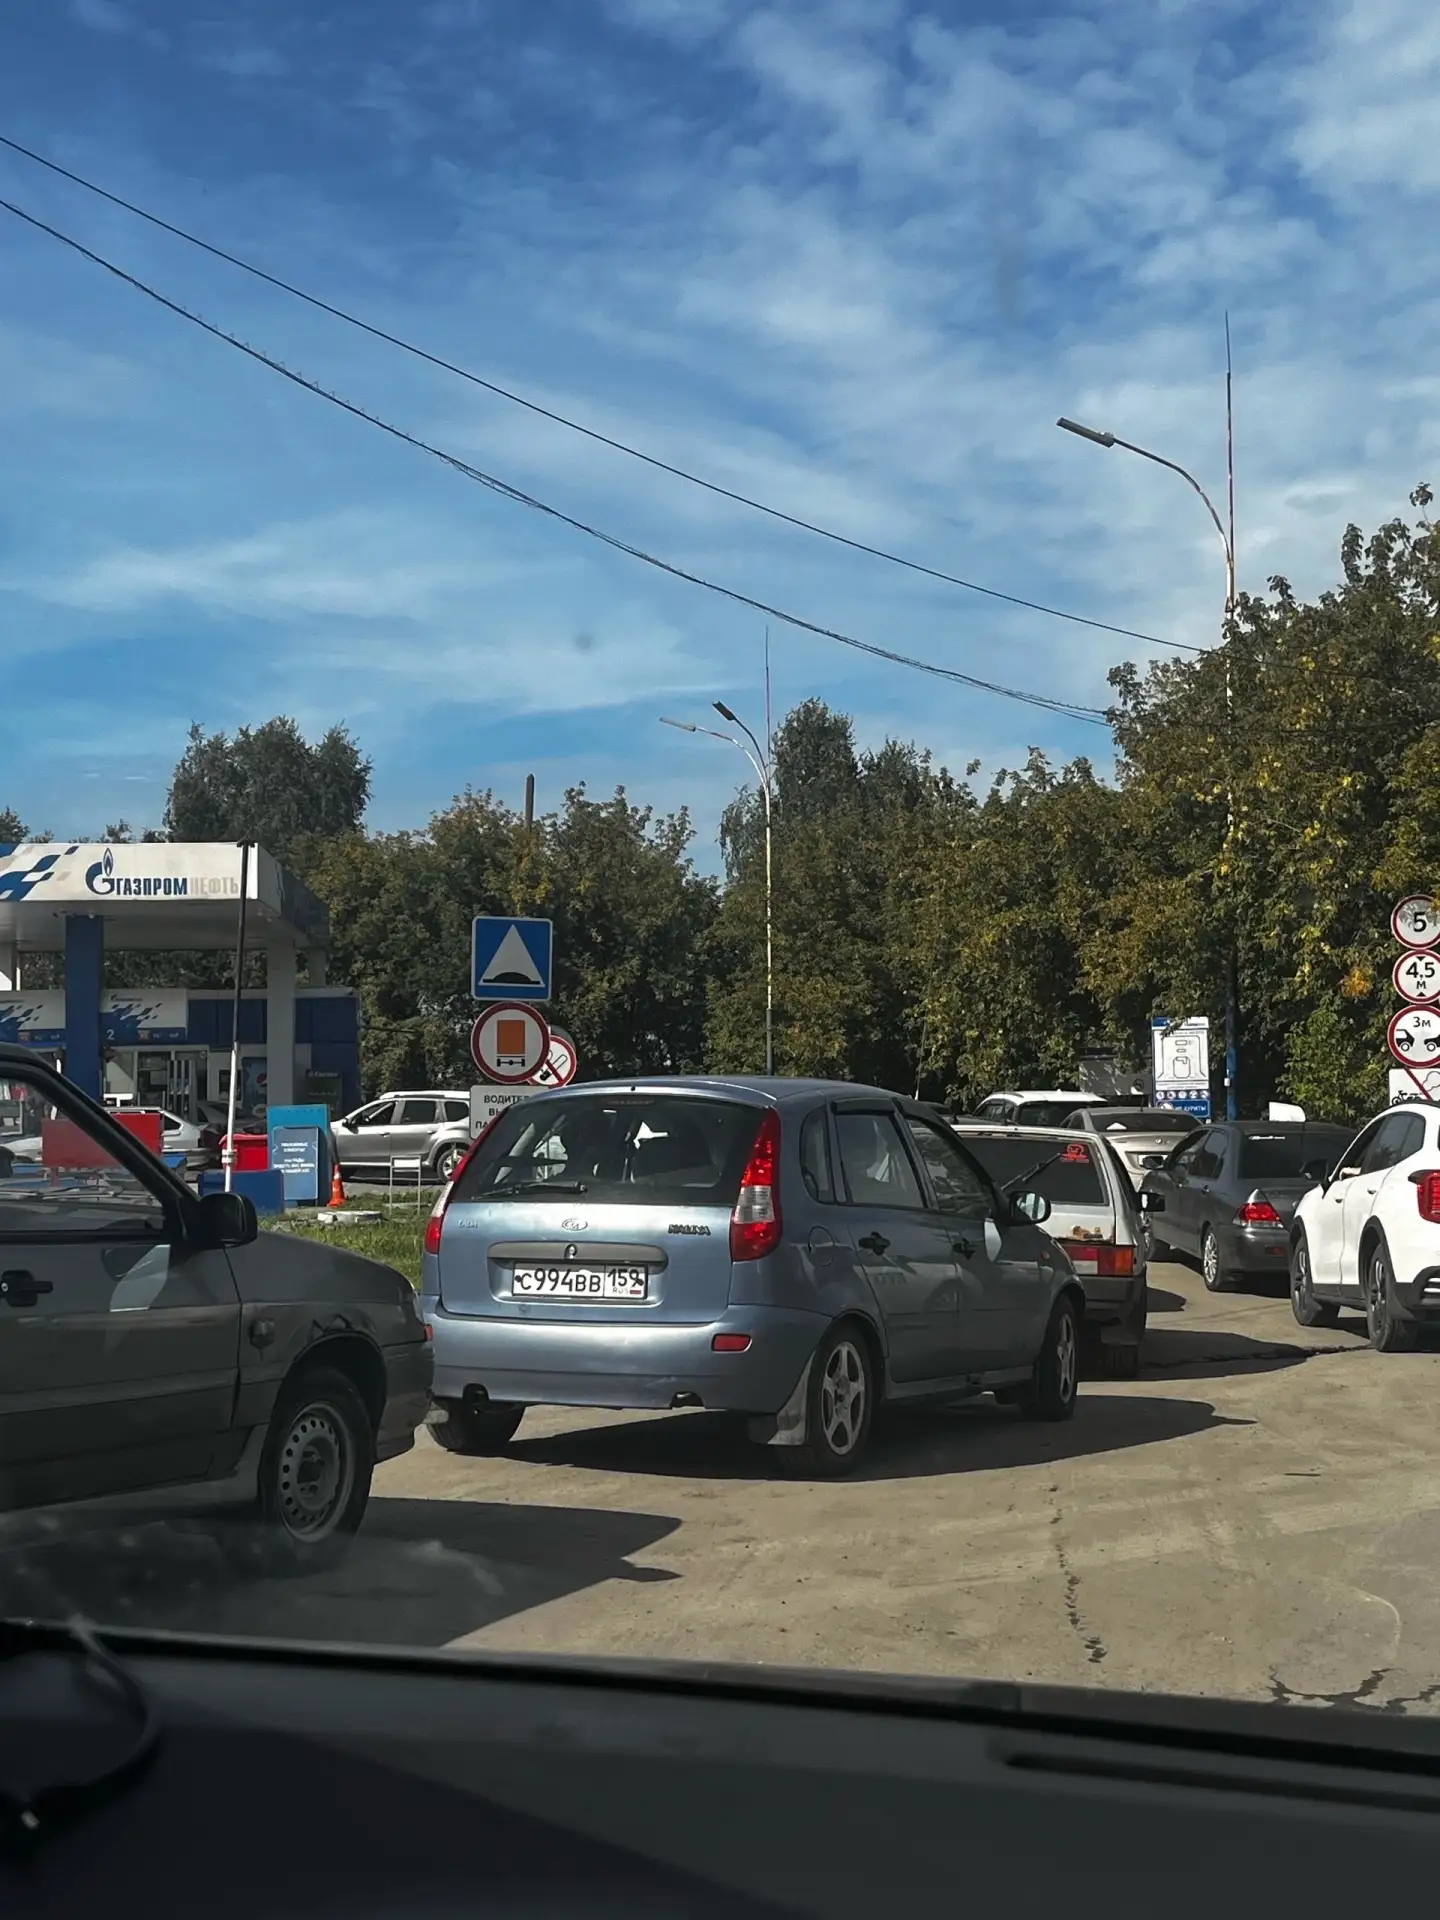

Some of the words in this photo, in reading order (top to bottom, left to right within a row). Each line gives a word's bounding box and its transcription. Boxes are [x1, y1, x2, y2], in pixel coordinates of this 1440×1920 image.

[116, 877, 188, 896] ГАЗПРОМ
[190, 876, 239, 895] НЕФТЬ
[1412, 911, 1427, 933] 5
[1405, 961, 1436, 980] 4,5
[106, 1029, 115, 1040] 2
[518, 1267, 601, 1293] С994ВВ
[606, 1268, 640, 1288] 159
[610, 1286, 630, 1294] RUS
